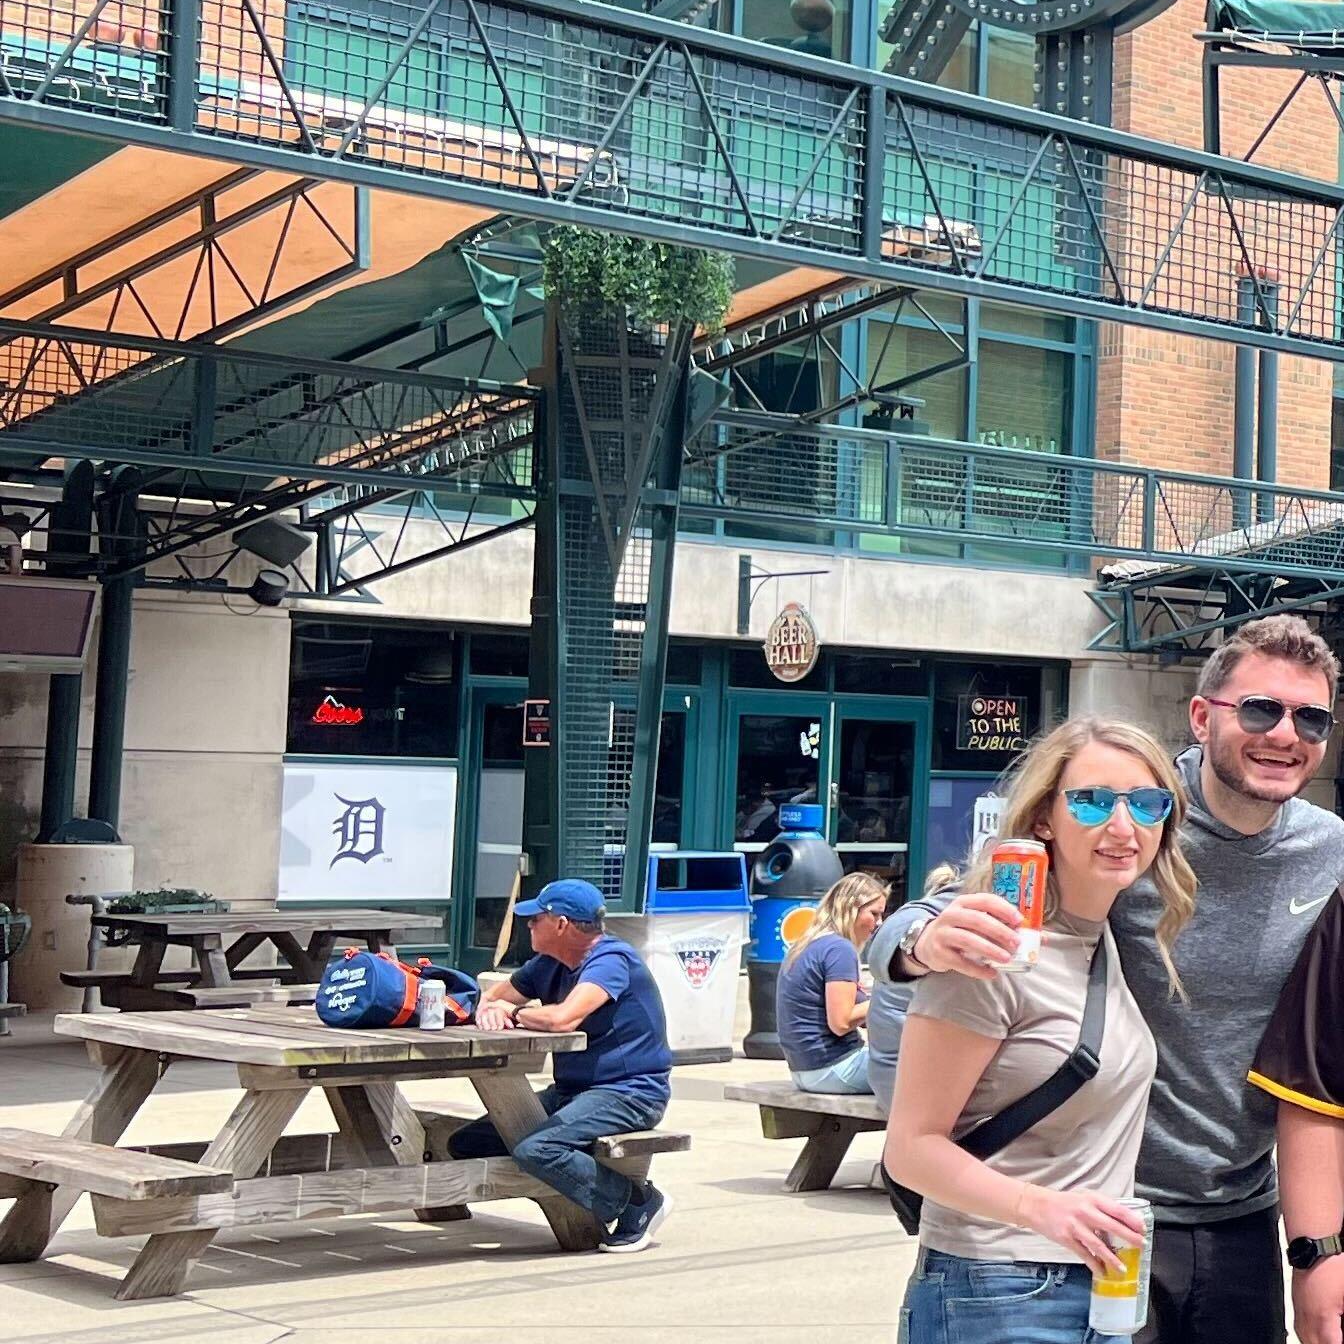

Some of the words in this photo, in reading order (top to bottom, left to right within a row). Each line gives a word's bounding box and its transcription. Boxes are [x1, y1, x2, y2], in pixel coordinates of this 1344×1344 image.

[771, 626, 808, 646] BEER
[768, 645, 809, 665] HALL
[971, 697, 1016, 716] OPEN
[969, 718, 990, 734] TO
[992, 717, 1021, 733] THE
[967, 735, 1022, 751] PUBLIC
[328, 792, 387, 871] D
